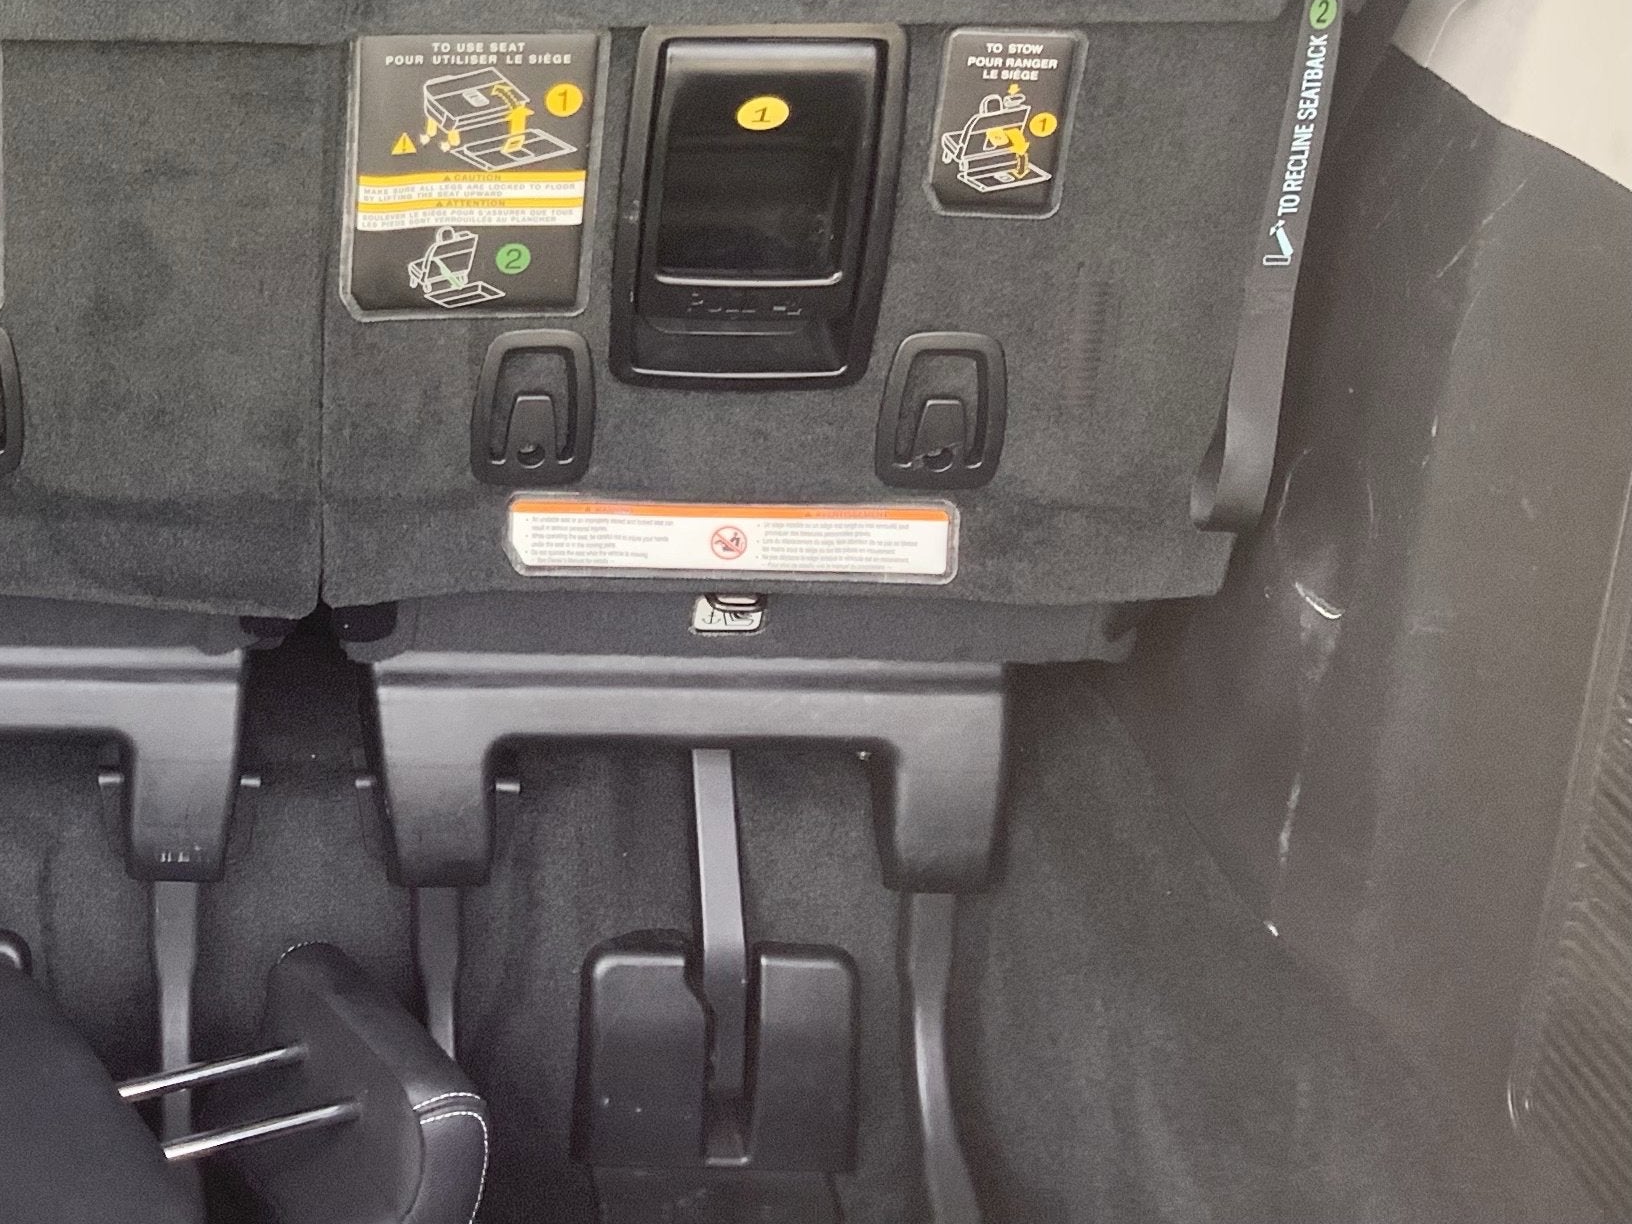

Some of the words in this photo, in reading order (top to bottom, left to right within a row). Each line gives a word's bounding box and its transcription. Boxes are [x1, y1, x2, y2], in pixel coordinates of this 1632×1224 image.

[1316, 0, 1329, 23] 2
[431, 42, 451, 53] TO
[456, 42, 482, 53] USE
[490, 42, 526, 52] SEAT
[986, 43, 1003, 54] TO
[1008, 43, 1043, 54] STOW
[385, 55, 424, 65] POUR
[432, 54, 497, 65] UTILISER
[506, 54, 523, 64] LE
[529, 52, 572, 64] SIÈGE
[967, 57, 1003, 67] POUR
[1005, 58, 1058, 69] RANGER
[982, 69, 999, 80] LE
[1001, 68, 1039, 80] SIÈGE
[1297, 34, 1329, 121] SEATBACK
[558, 89, 568, 111] 1
[751, 107, 771, 123] 1
[1283, 123, 1315, 193] RECLINE
[454, 174, 501, 182] CAUTION
[447, 199, 506, 207] ATTENTION
[1277, 194, 1301, 217] TO
[505, 248, 522, 269] 2
